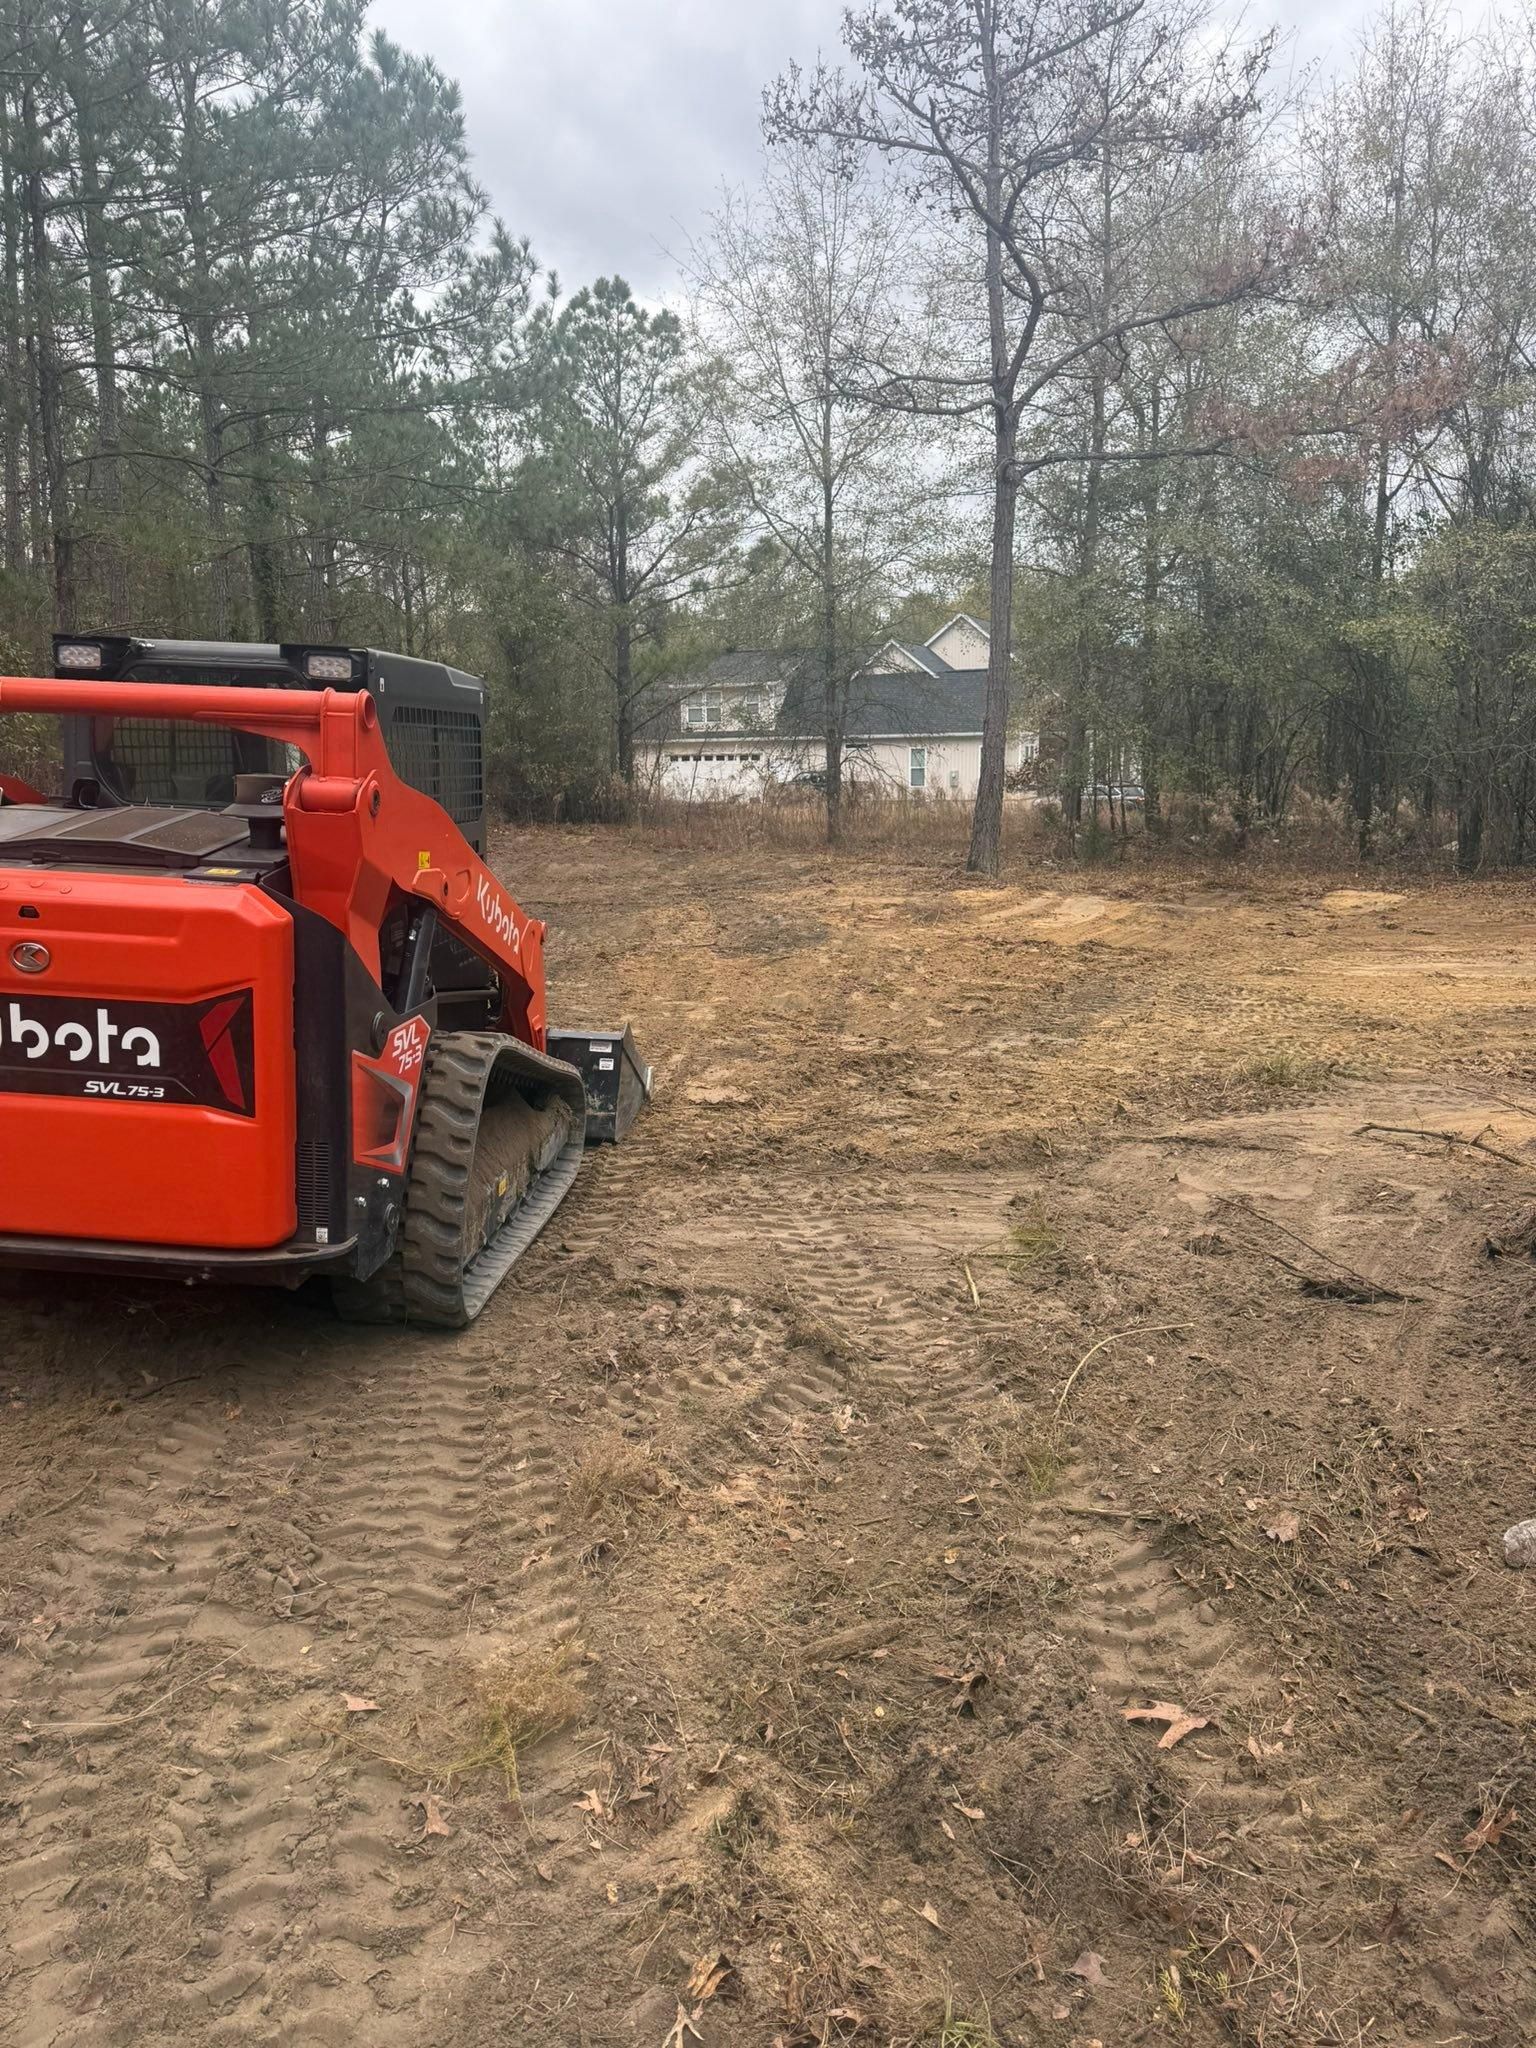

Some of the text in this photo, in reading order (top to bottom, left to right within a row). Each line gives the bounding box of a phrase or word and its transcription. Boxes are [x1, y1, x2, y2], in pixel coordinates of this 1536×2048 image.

[477, 873, 520, 955] Kubota
[0, 1002, 161, 1068] bota
[392, 1022, 421, 1058] SVL
[398, 1044, 422, 1075] 75-3
